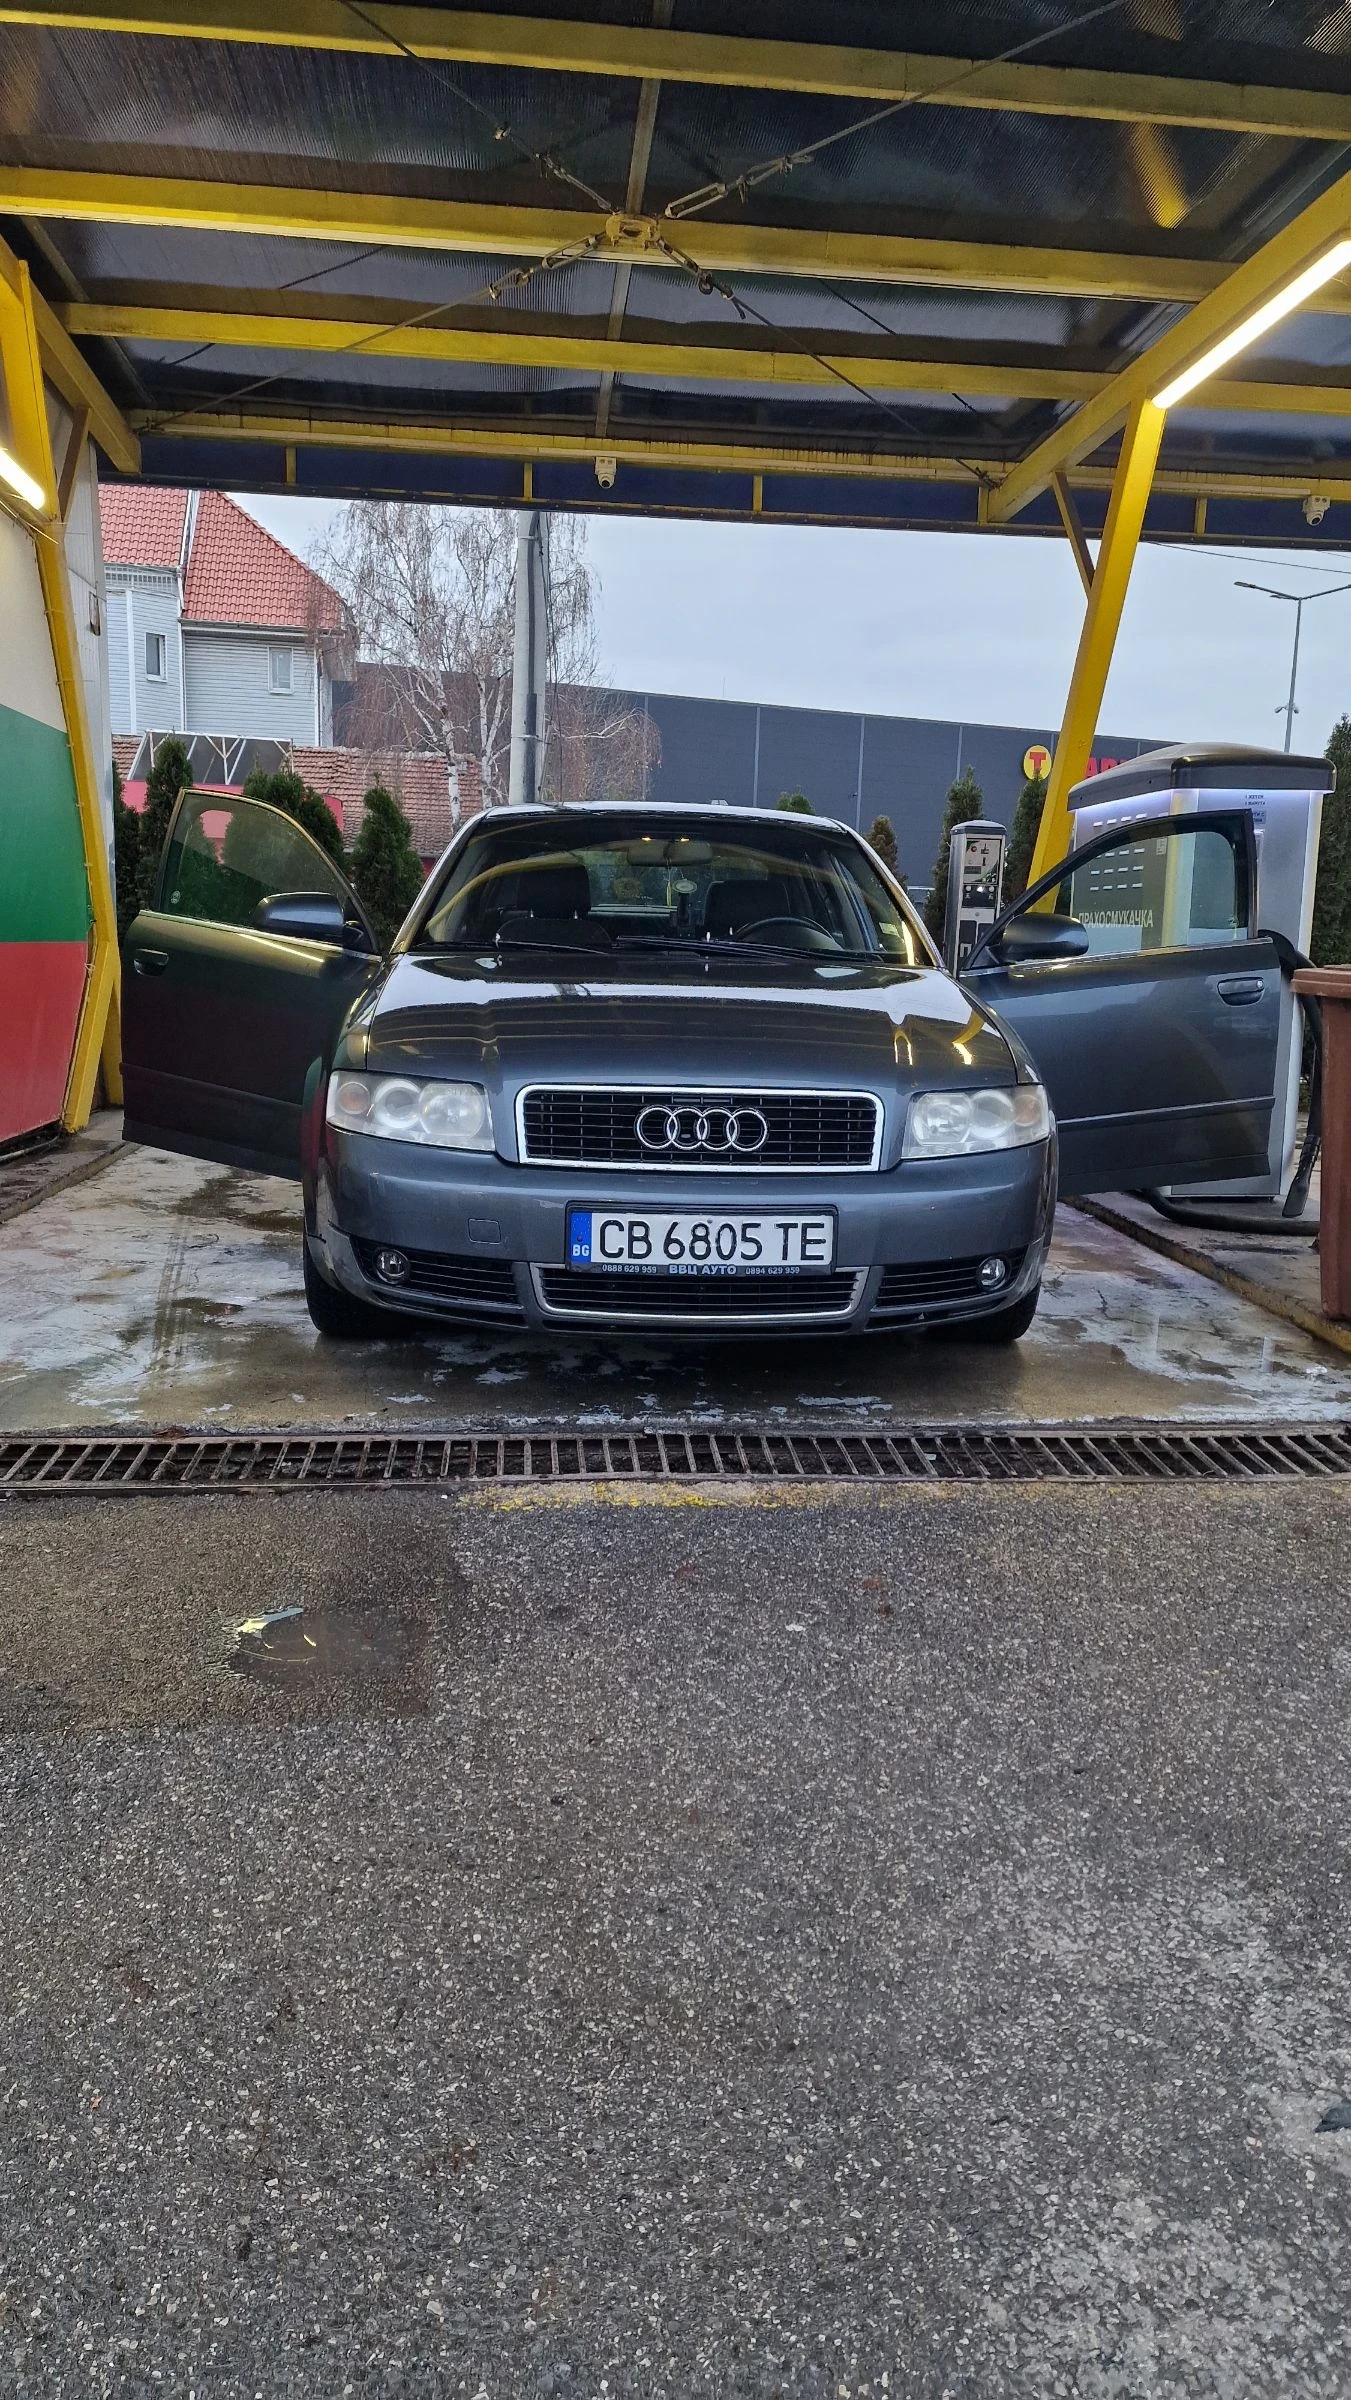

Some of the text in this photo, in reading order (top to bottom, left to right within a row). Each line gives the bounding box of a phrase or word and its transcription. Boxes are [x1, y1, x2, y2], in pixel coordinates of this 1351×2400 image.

[1029, 751, 1047, 771] T
[1078, 909, 1154, 929] ПРАХОСМУКАЧКА
[599, 1219, 827, 1261] CB 6805 TE
[572, 1244, 590, 1257] BG
[602, 1264, 657, 1274] 0888 629 959
[701, 1265, 737, 1275] АУТО
[745, 1266, 800, 1275] 0894 629 959
